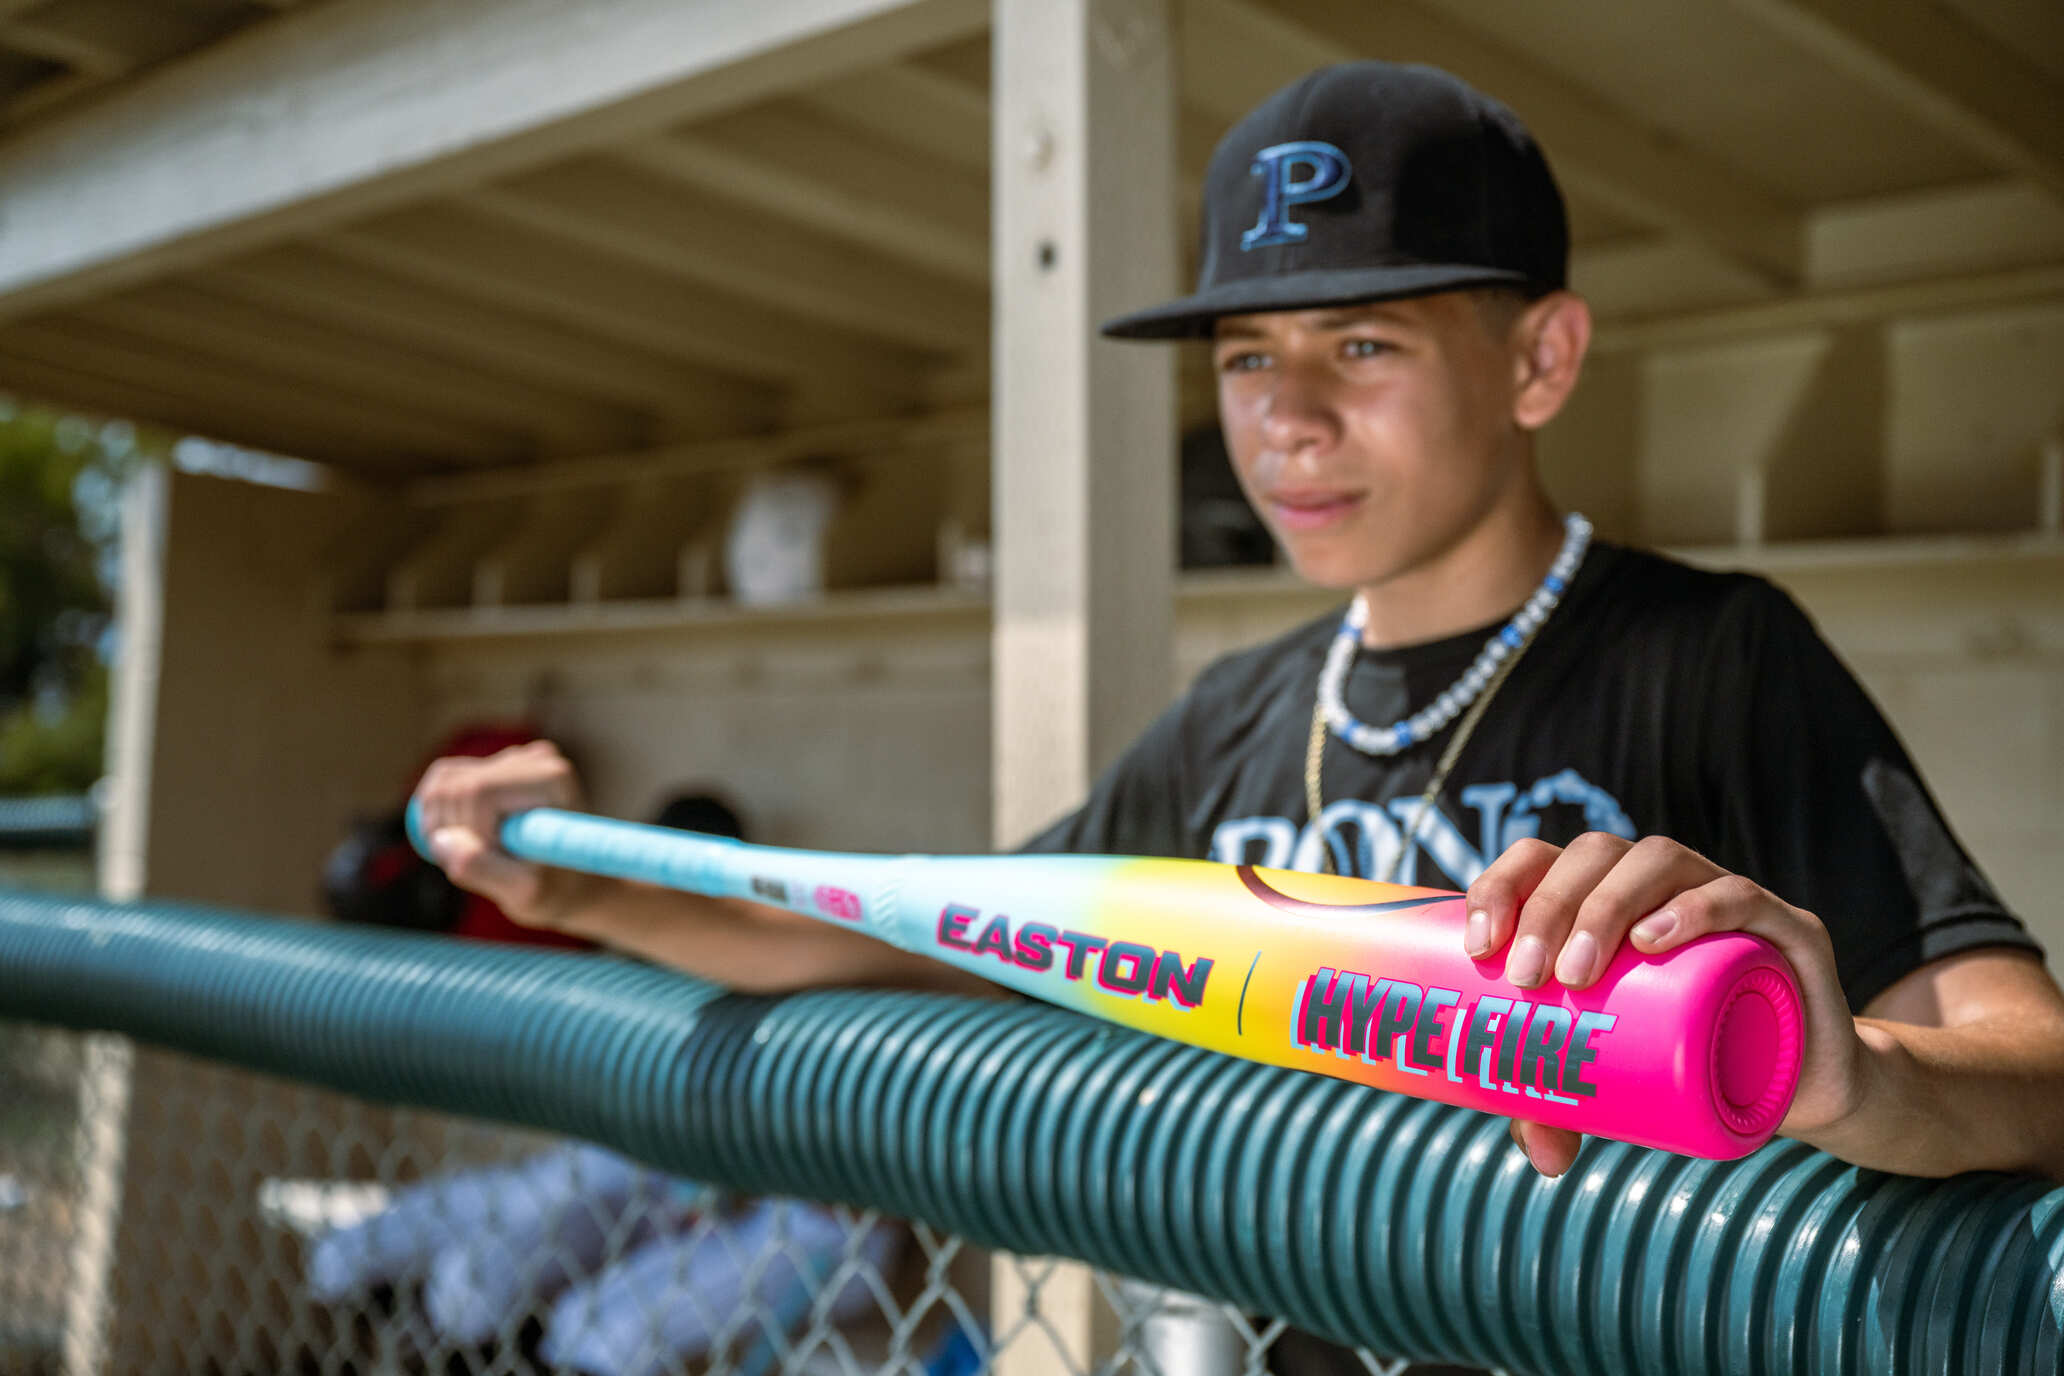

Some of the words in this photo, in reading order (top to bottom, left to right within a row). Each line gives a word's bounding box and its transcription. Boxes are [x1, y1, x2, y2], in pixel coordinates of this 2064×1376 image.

[1240, 140, 1353, 252] P
[937, 903, 1215, 1012] EASTON
[1290, 966, 1462, 1076] HYPE
[1447, 994, 1619, 1106] FIRE
